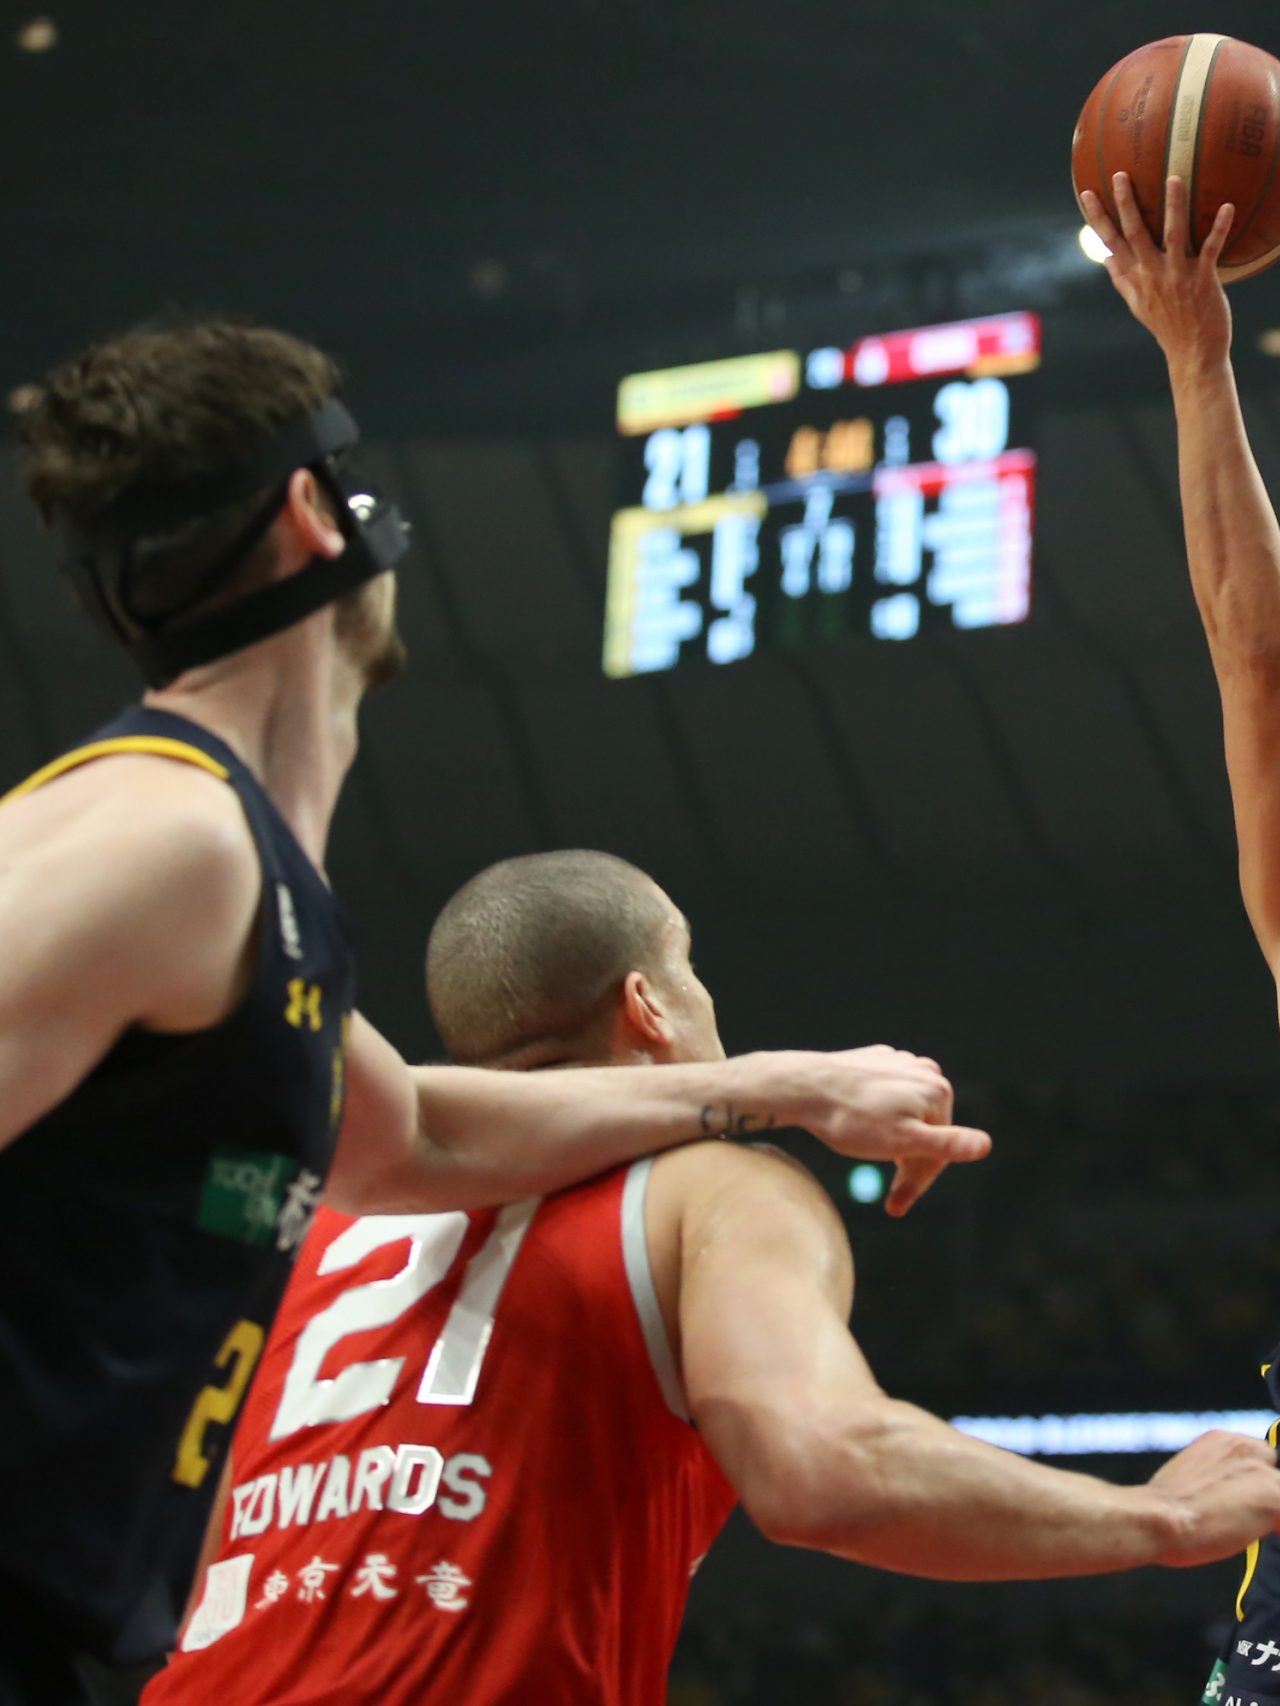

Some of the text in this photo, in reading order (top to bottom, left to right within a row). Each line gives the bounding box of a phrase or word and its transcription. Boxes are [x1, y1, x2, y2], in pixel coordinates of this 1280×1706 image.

[933, 378, 1010, 464] 30
[642, 425, 710, 510] 21
[269, 1195, 541, 1442] 21
